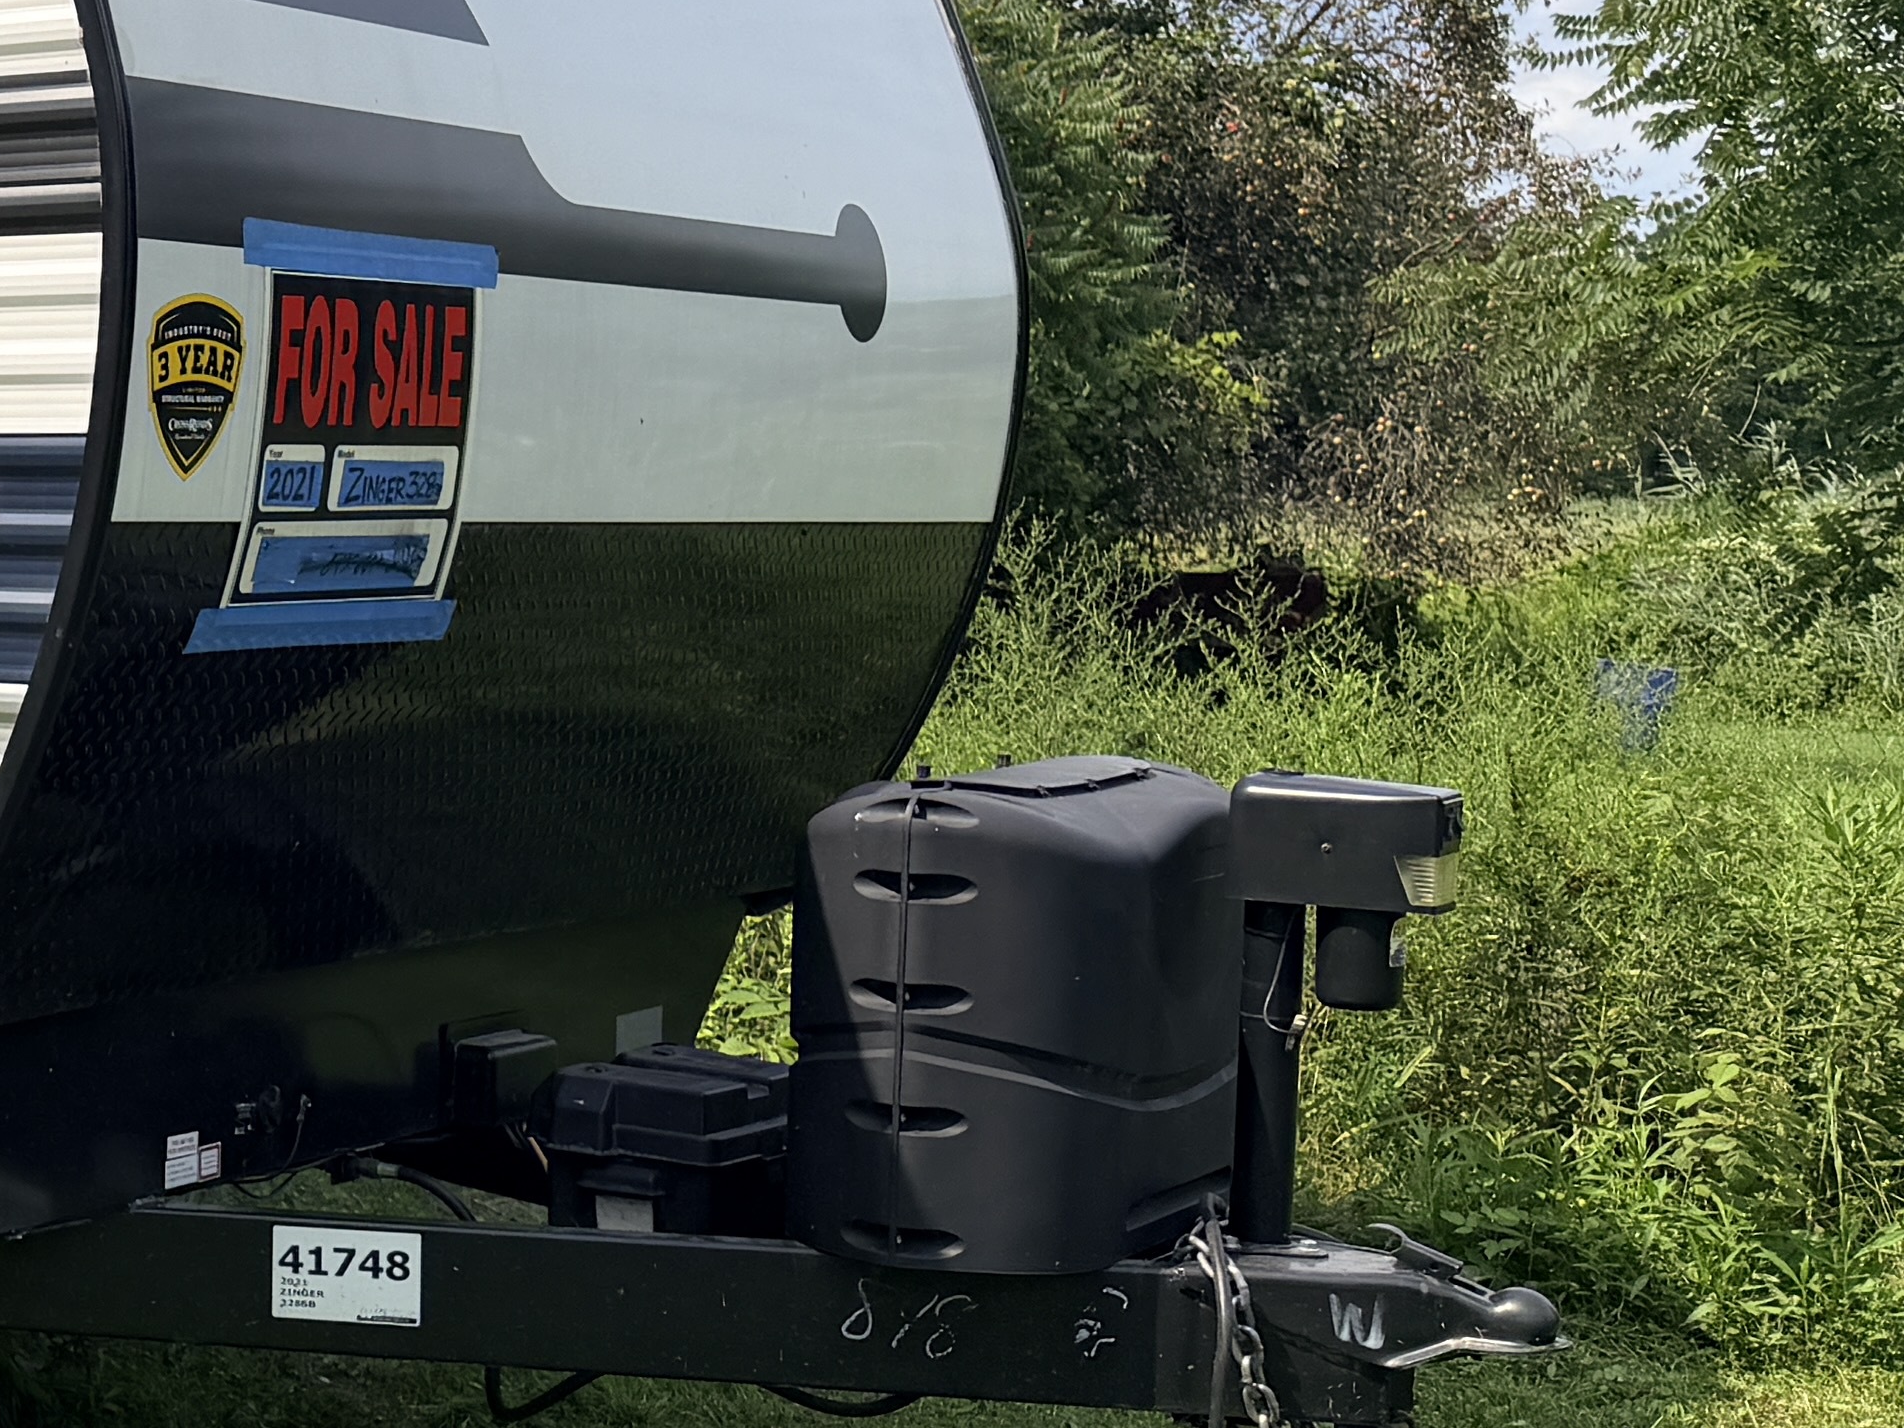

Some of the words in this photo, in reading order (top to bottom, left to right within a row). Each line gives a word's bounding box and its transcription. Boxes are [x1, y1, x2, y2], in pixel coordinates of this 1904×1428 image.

[157, 350, 170, 383] 3
[177, 343, 236, 383] YEAR
[272, 294, 359, 428] FOR
[369, 299, 467, 428] SALE
[266, 464, 317, 502] 2021
[278, 1244, 410, 1282] 41748
[280, 1276, 308, 1287] 2021
[280, 1288, 325, 1299] ZINGER
